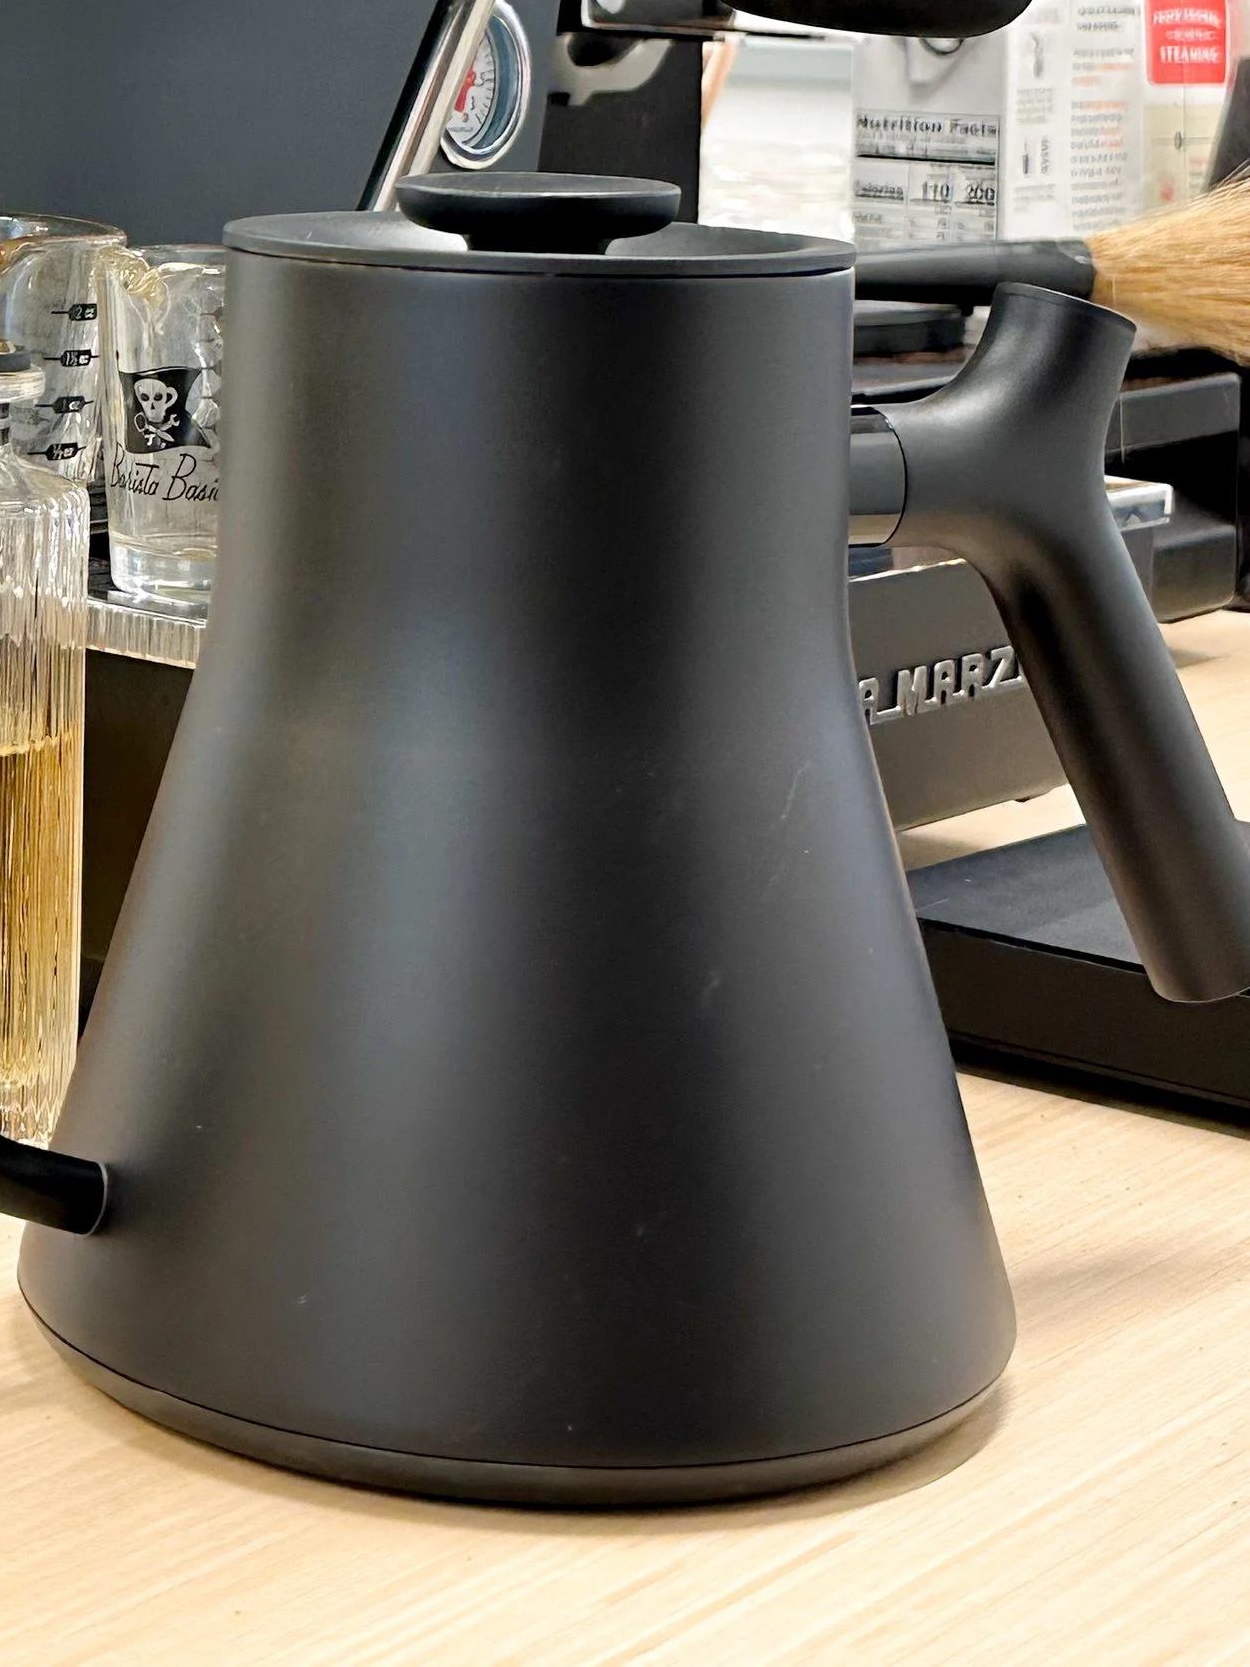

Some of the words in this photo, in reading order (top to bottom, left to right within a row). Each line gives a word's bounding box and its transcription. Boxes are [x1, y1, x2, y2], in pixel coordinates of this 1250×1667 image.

[856, 115, 943, 134] Nutrition
[110, 441, 160, 496] Barista
[897, 645, 1025, 717] MARZ
